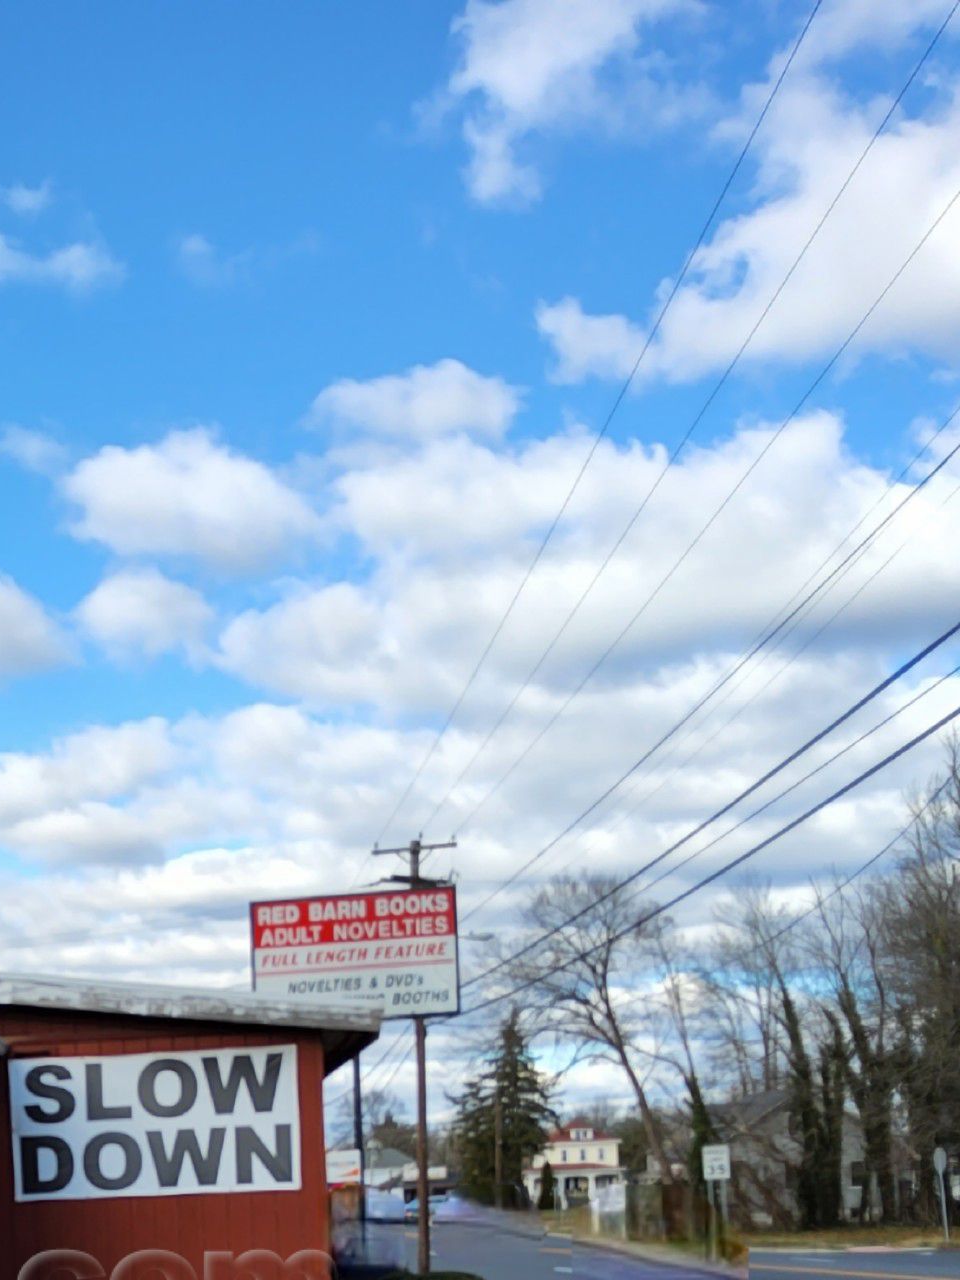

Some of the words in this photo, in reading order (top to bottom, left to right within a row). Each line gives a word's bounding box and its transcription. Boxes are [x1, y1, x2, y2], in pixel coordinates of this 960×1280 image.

[257, 905, 300, 926] RED
[308, 901, 366, 922] BARN
[375, 893, 449, 917] BOOKS
[260, 925, 322, 947] ADULT
[333, 915, 449, 941] NOVELTIES
[261, 953, 300, 968] FULL
[306, 947, 368, 966] LENGTH
[374, 941, 448, 960] FEATURE
[288, 976, 361, 995] NOVELTIES
[385, 973, 424, 989] DVD's
[392, 989, 449, 1006] BOOTHS
[23, 1052, 283, 1125] SLOW
[20, 1123, 293, 1195] DOWN
